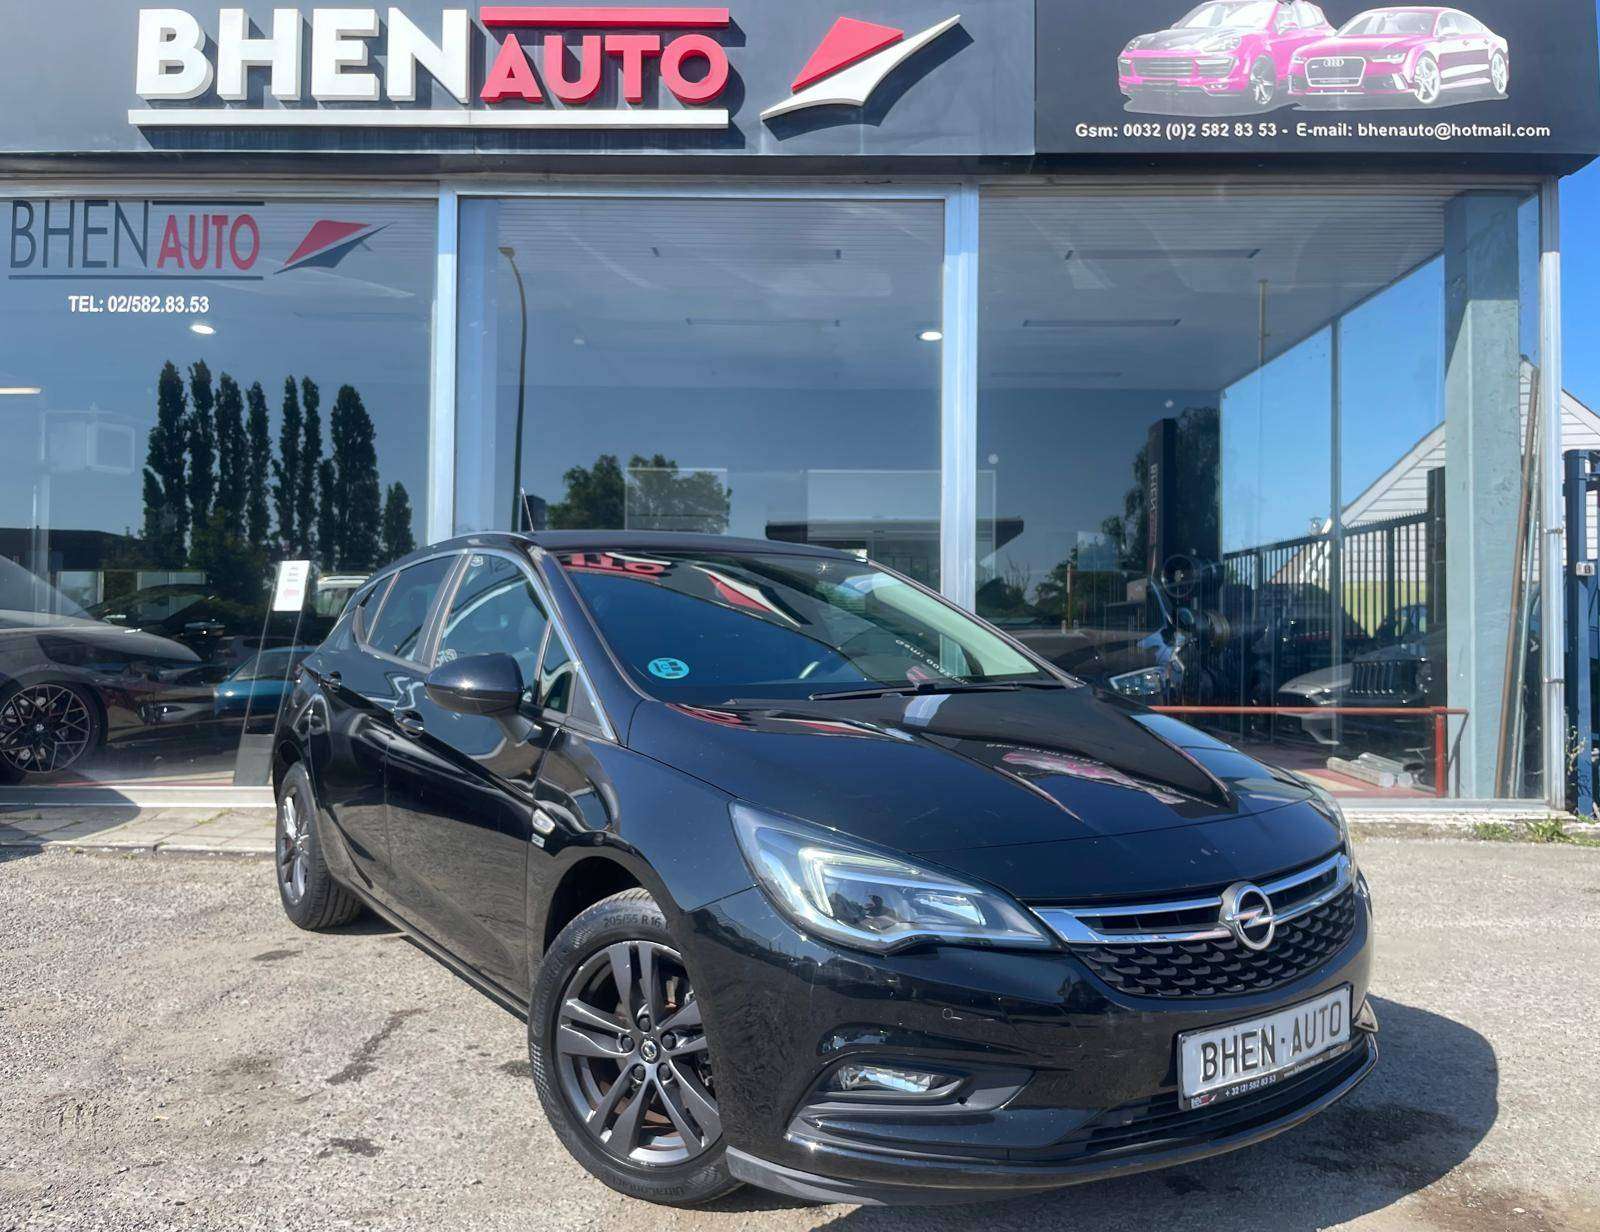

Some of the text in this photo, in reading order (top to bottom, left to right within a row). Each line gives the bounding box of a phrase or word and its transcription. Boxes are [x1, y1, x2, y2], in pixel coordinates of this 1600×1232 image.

[1075, 123, 1118, 138] Gsm:
[1123, 123, 1161, 137] 0032
[1166, 123, 1196, 140] (0)2
[1201, 123, 1229, 137] 582
[1234, 123, 1253, 137] 83
[1258, 123, 1277, 137] 53
[1296, 122, 1352, 137] E-mail:
[1358, 122, 1551, 140] bhenauto@hotmail.com
[68, 295, 209, 313] TEL: 02/582.83.53
